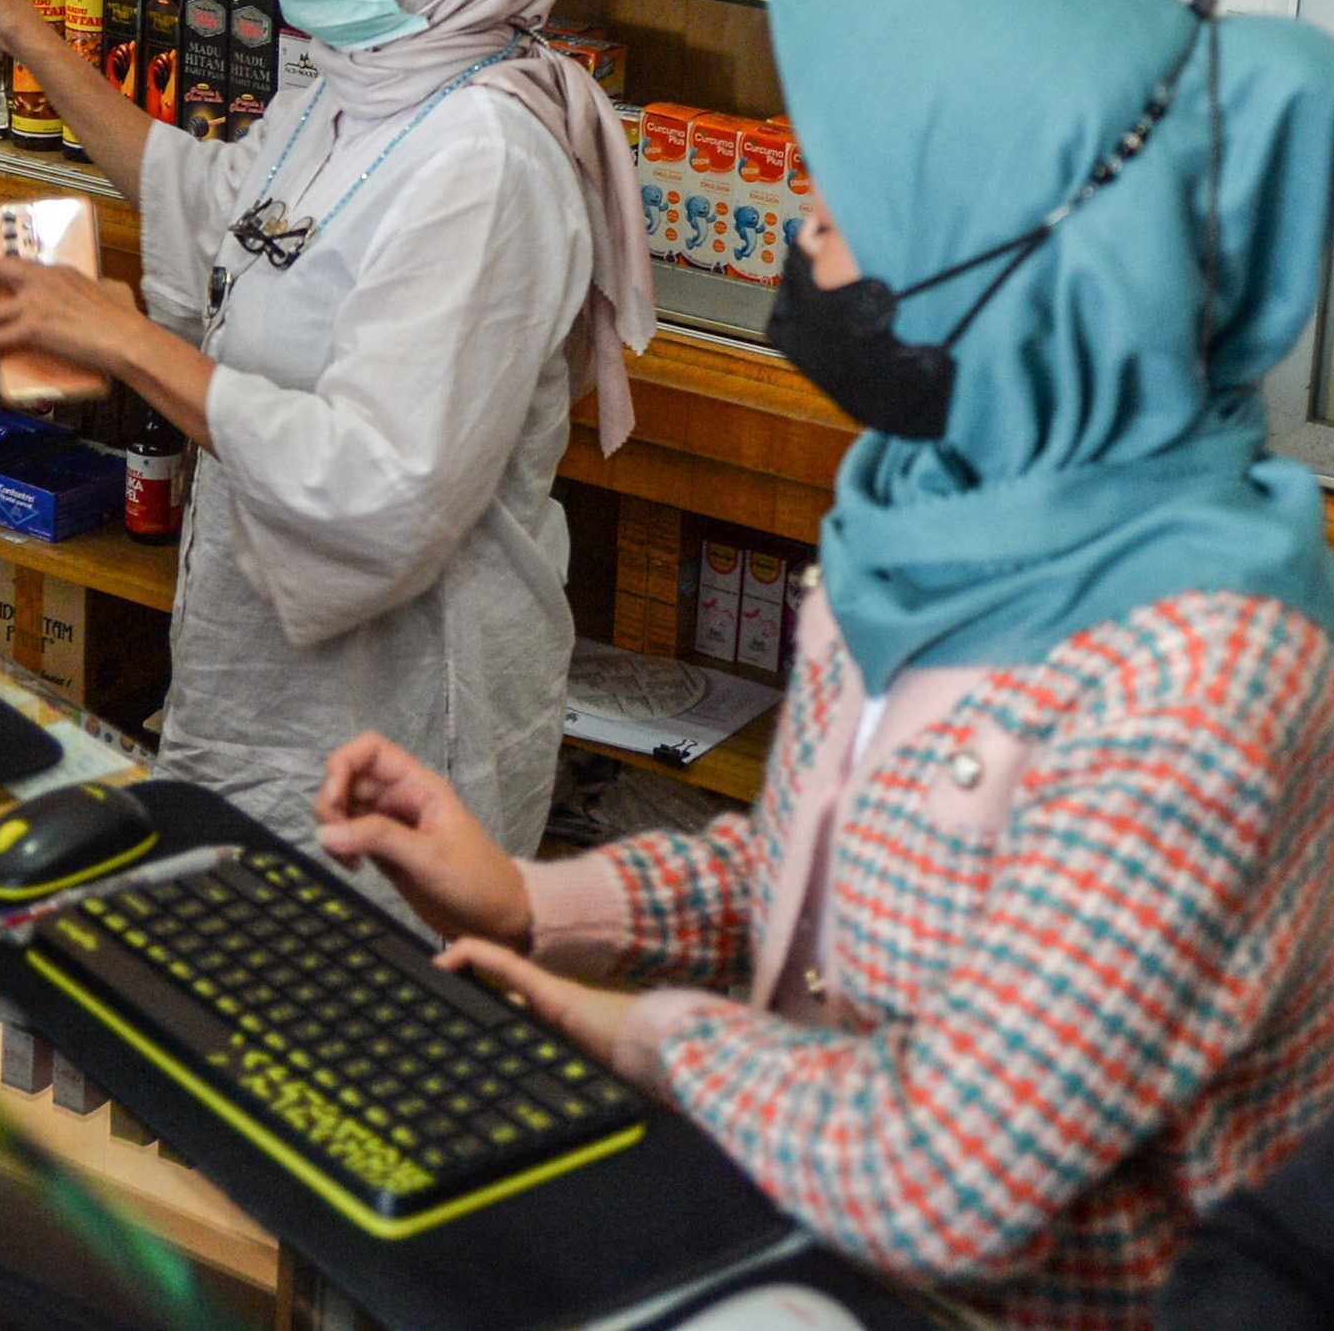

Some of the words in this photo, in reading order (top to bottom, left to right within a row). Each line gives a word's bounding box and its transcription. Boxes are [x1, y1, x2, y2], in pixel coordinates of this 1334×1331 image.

[188, 42, 223, 57] MADU
[185, 53, 226, 72] HITAM
[233, 52, 267, 68] MADU
[231, 64, 271, 83] HITAM
[647, 121, 686, 137] Curcuma
[668, 135, 685, 146] Plus
[695, 132, 734, 148] Curcuma
[717, 146, 734, 157] Plus
[744, 141, 784, 158] Curcuma
[766, 155, 783, 167] Plus
